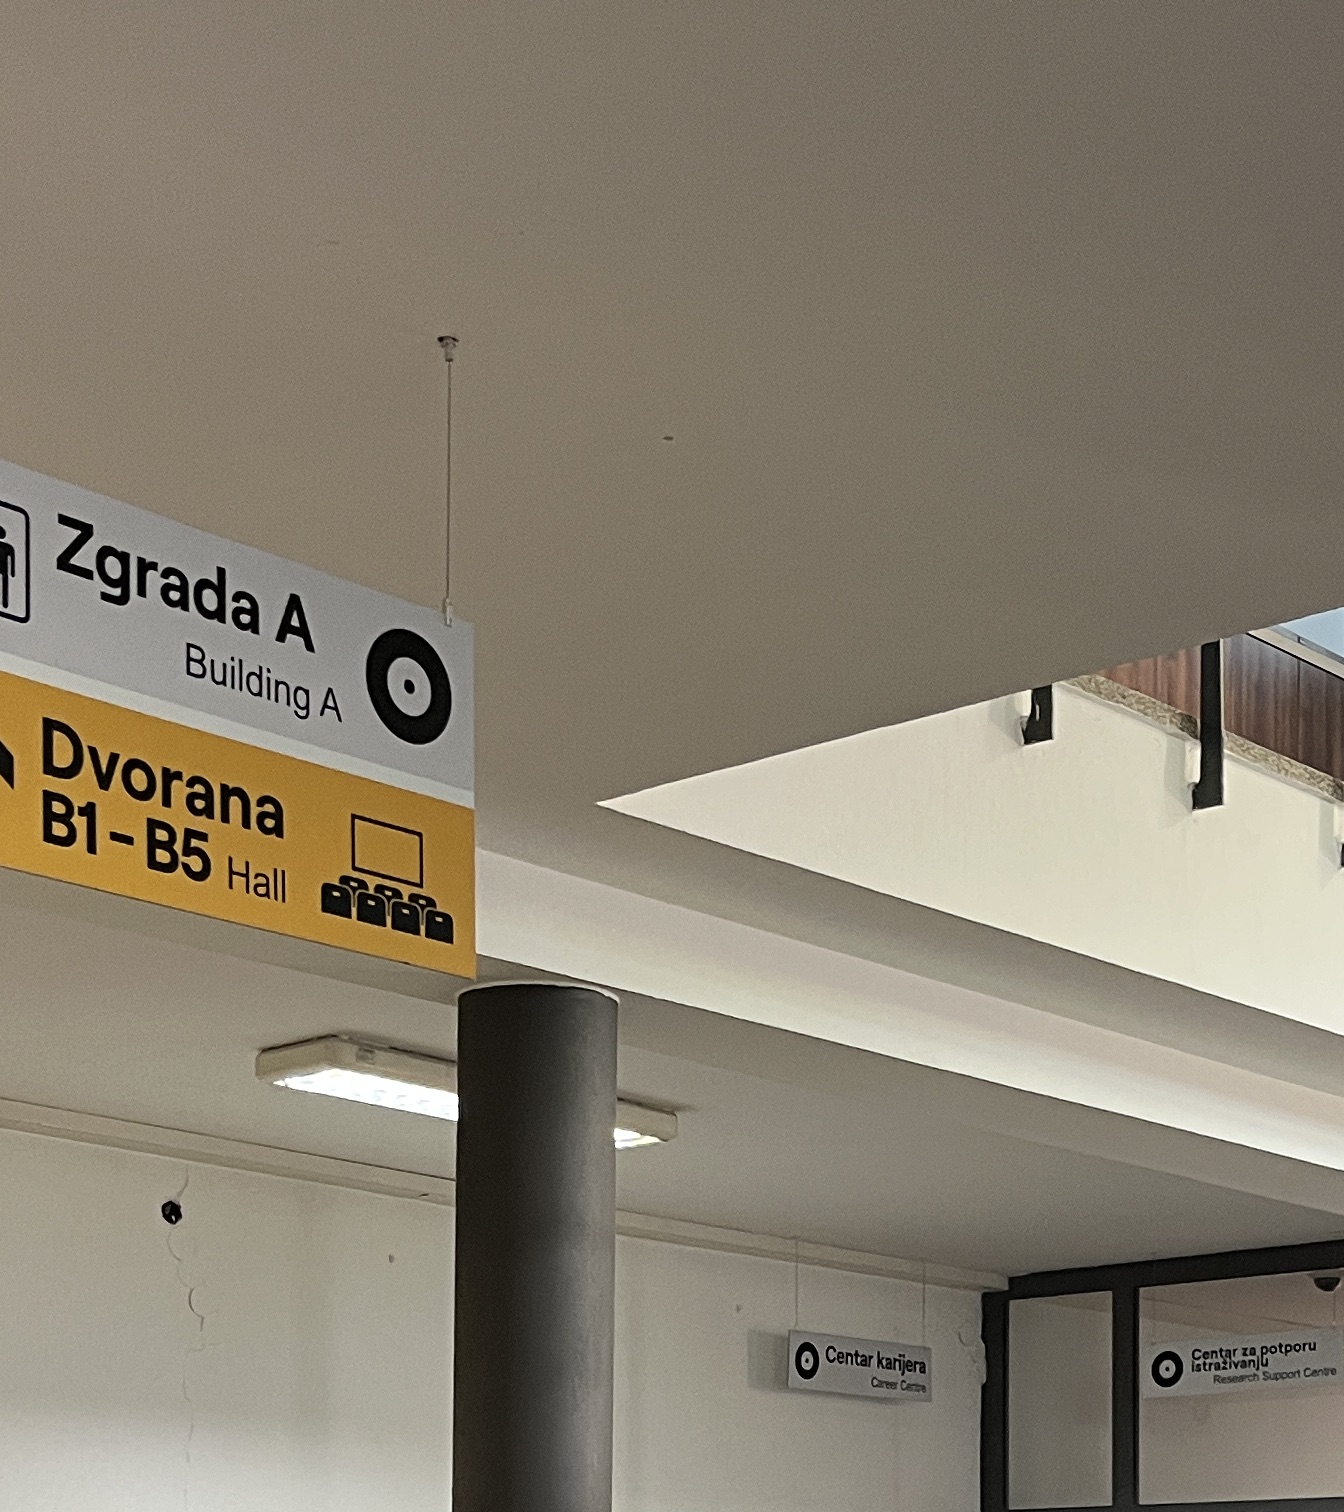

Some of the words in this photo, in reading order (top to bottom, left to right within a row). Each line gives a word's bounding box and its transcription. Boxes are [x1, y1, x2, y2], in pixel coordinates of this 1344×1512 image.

[56, 513, 260, 635] Zgrada
[275, 592, 316, 654] A
[185, 642, 311, 720] Building
[320, 686, 343, 723] A
[42, 716, 285, 840] Dvorana
[227, 856, 287, 904] Hall
[825, 1345, 874, 1368] Centar
[876, 1350, 927, 1376] karijera
[1191, 1348, 1239, 1361] Centar
[1242, 1346, 1257, 1357] za
[1260, 1341, 1317, 1359] potporu
[1191, 1354, 1269, 1373] istraživanju
[870, 1376, 898, 1391] Career
[900, 1380, 927, 1394] Centre
[1213, 1372, 1260, 1385] Research
[1262, 1368, 1301, 1382] Support
[1303, 1366, 1337, 1378] Centre
